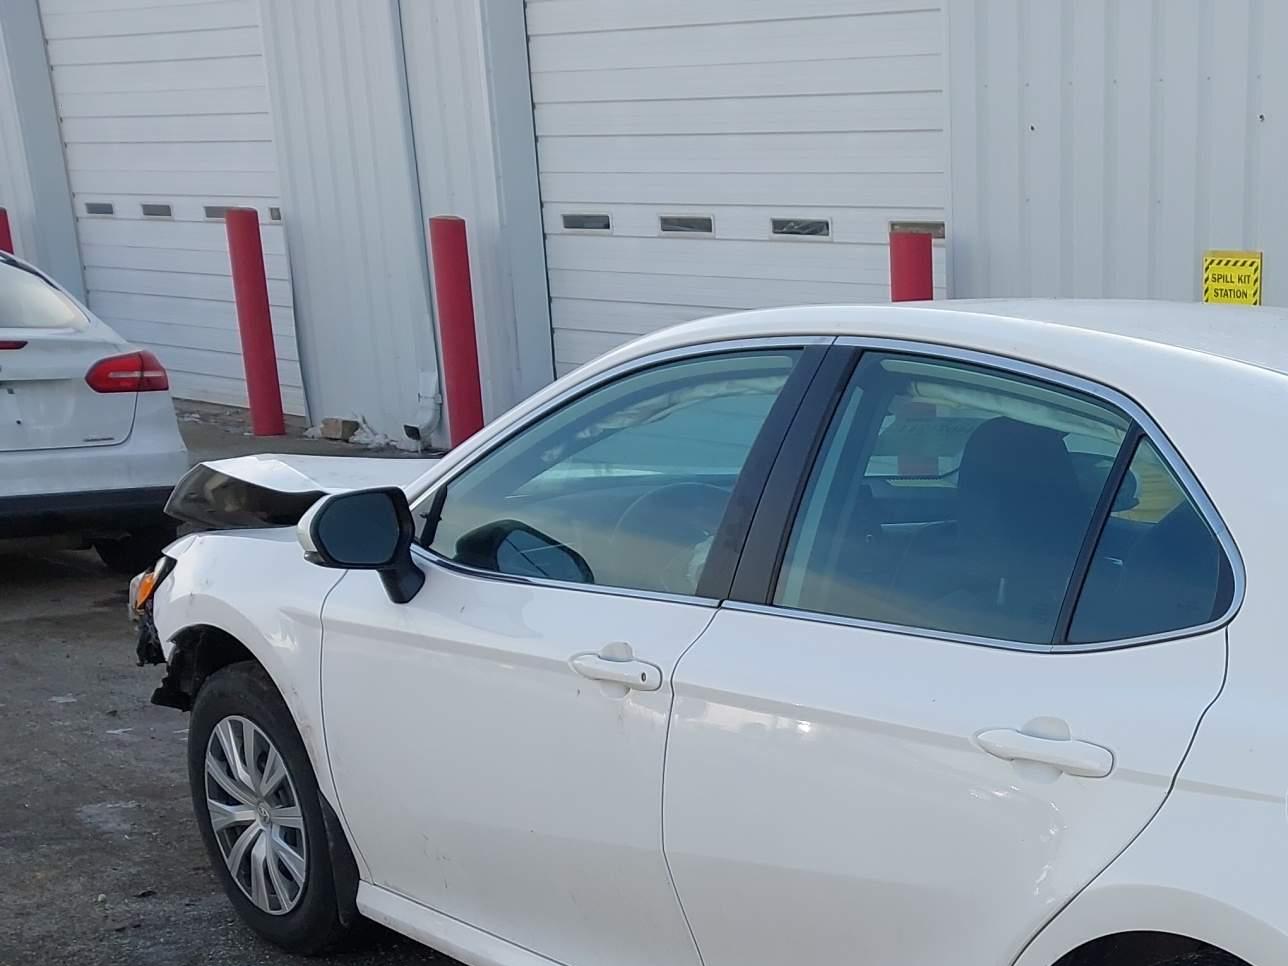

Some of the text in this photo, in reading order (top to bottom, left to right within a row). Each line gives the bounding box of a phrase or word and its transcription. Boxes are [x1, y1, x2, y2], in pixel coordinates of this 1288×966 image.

[1211, 273, 1251, 284] SPILL KIT
[1213, 287, 1248, 299] STATION
